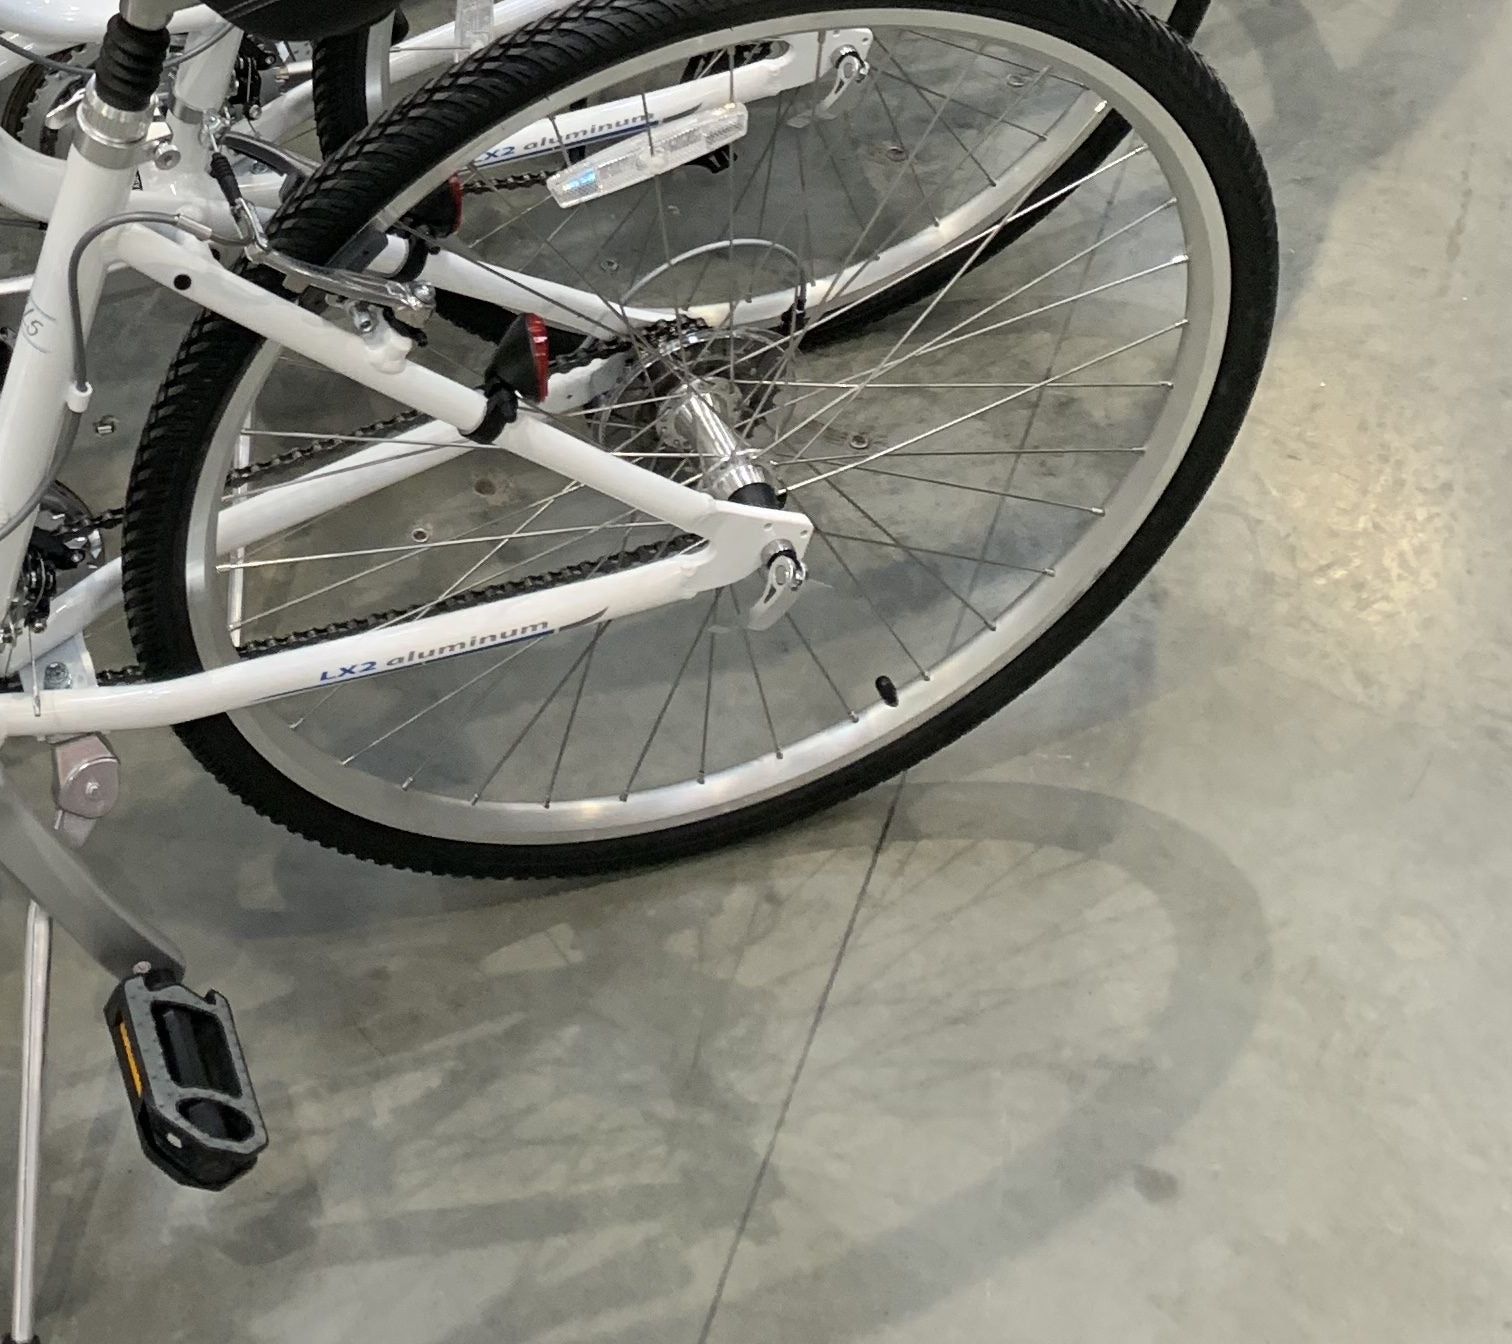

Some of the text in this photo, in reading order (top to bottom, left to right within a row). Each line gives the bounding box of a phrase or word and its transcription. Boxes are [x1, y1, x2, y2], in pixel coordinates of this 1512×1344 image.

[522, 112, 655, 152] aluminum
[319, 619, 550, 682] LX2 aluminum
